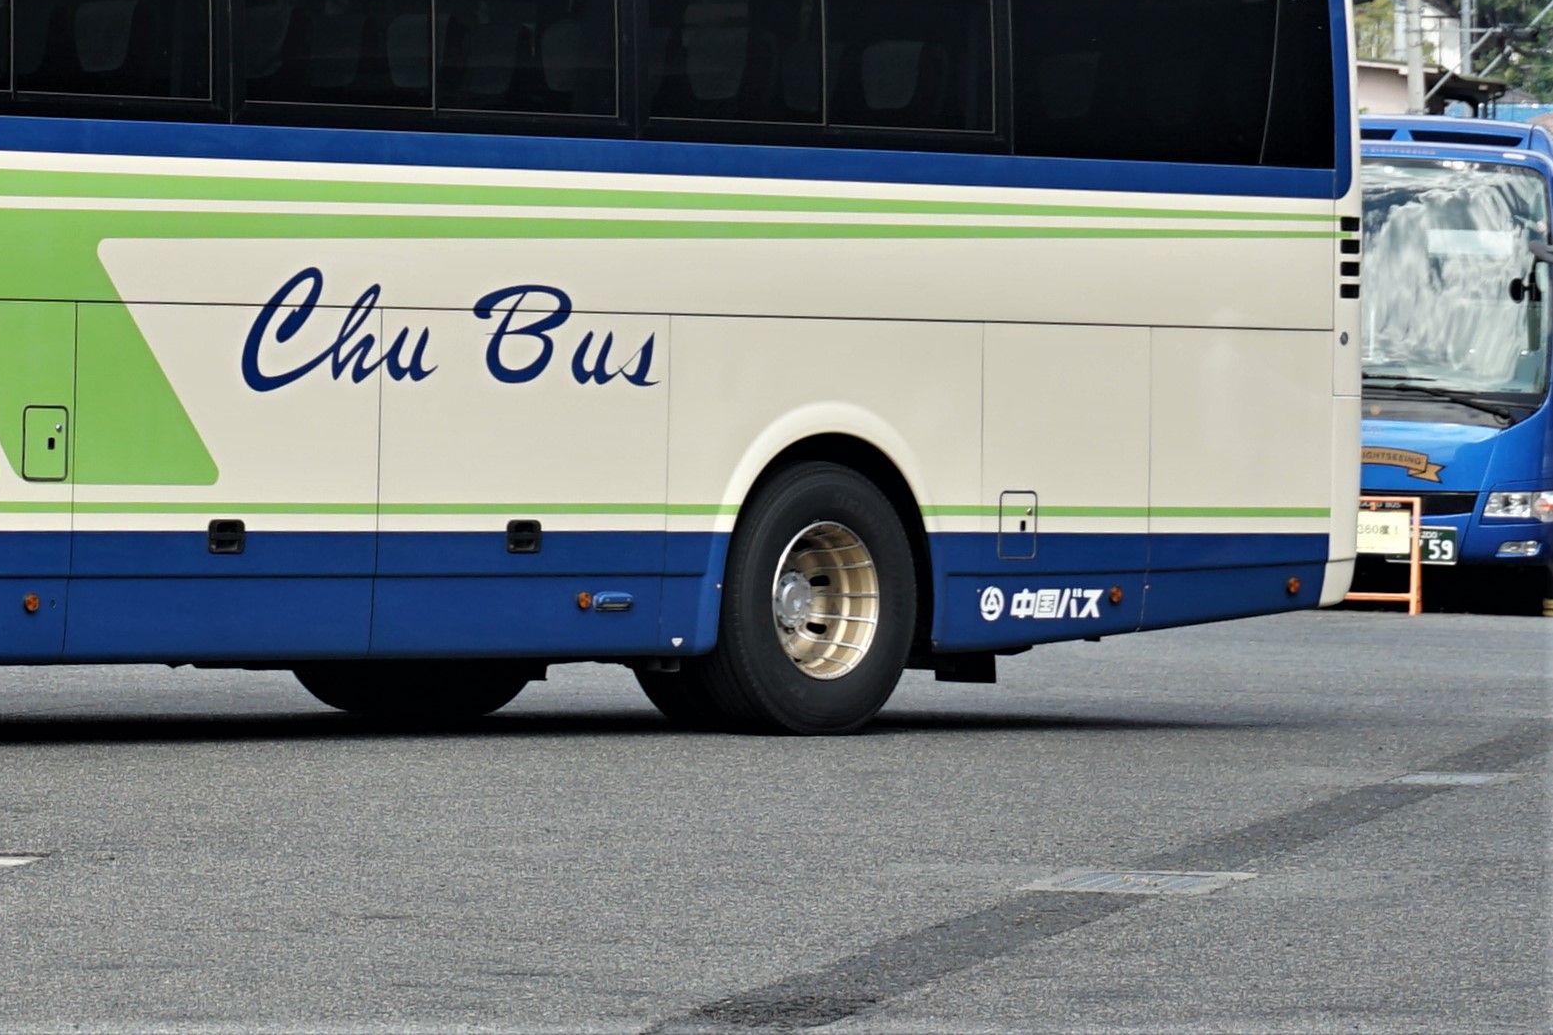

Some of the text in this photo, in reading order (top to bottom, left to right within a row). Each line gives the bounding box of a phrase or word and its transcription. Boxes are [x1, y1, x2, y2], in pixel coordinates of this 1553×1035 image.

[240, 266, 661, 393] Chu Bus
[1362, 451, 1421, 464] IGHTSEEING
[1419, 539, 1454, 560] 59
[1009, 588, 1104, 619] 中国バス
